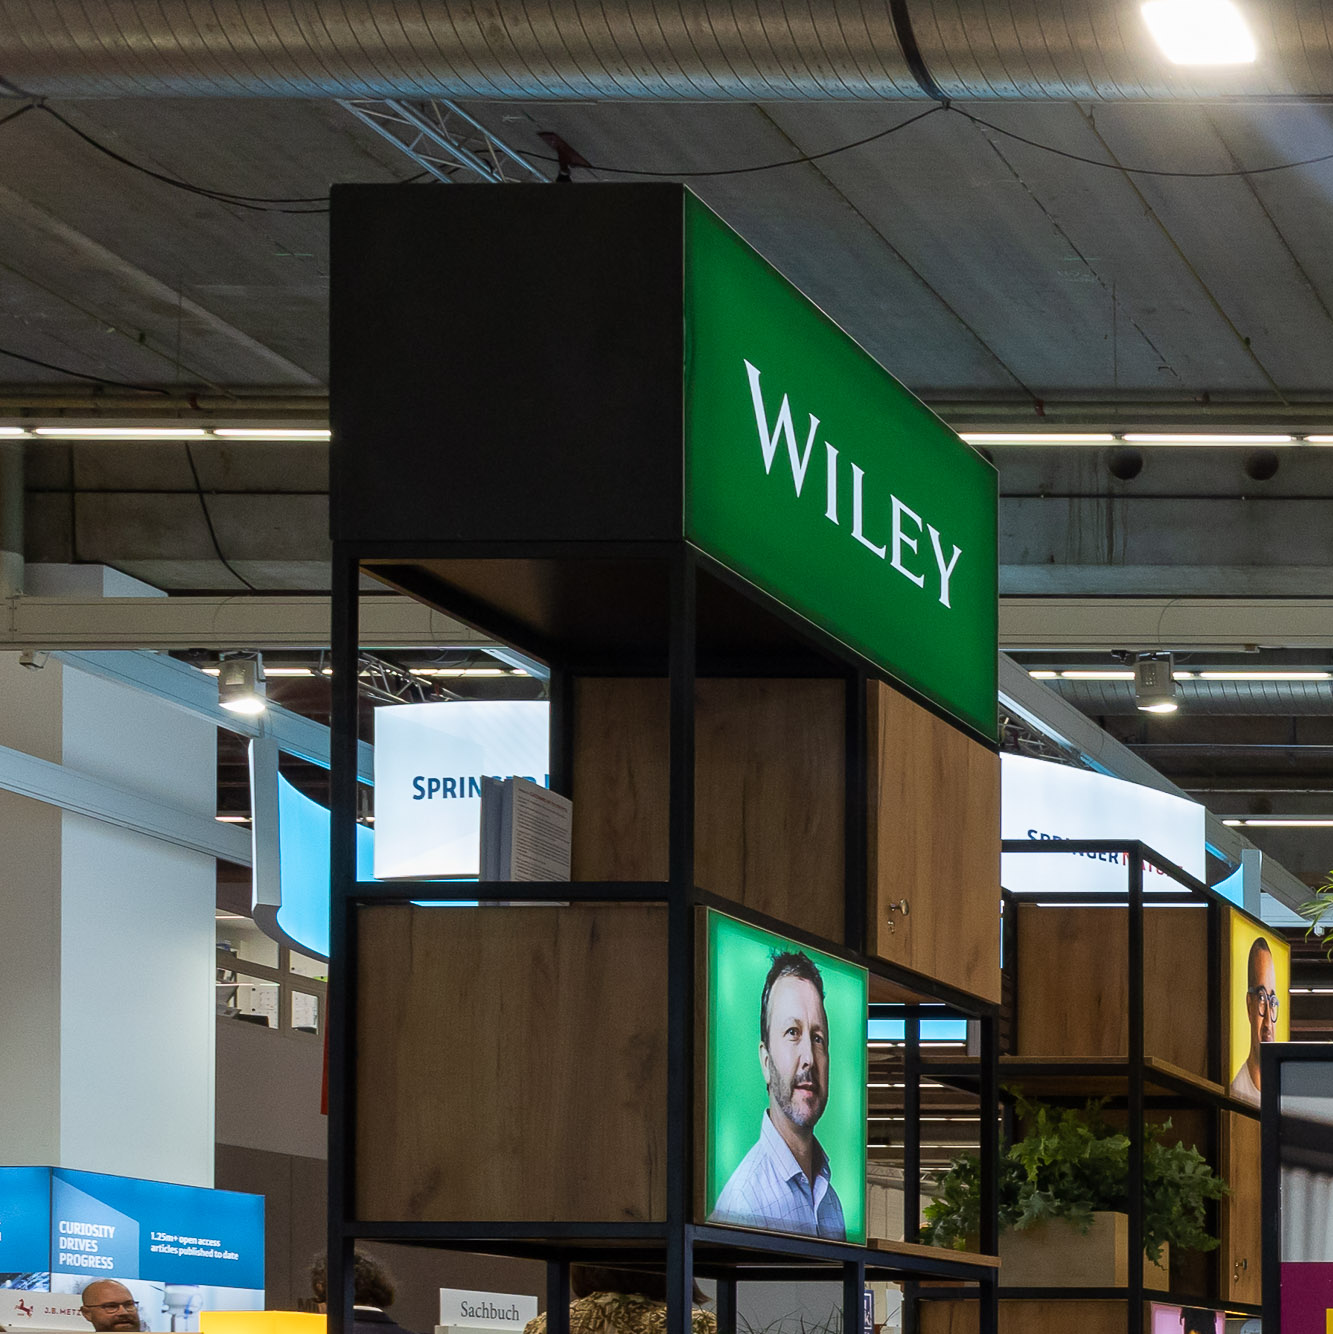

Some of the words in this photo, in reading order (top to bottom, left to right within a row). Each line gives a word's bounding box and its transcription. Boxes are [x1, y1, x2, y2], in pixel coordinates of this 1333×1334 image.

[743, 358, 962, 609] WILEY
[59, 1220, 115, 1239] CURIOSITY
[59, 1237, 98, 1253] DRIVES
[179, 1236, 197, 1245] open
[198, 1238, 221, 1247] access
[59, 1252, 114, 1270] PROGRESS
[150, 1244, 178, 1254] articles
[179, 1246, 213, 1258] published
[214, 1250, 222, 1258] to
[223, 1250, 239, 1260] date
[460, 1301, 520, 1321] Sachbuch
